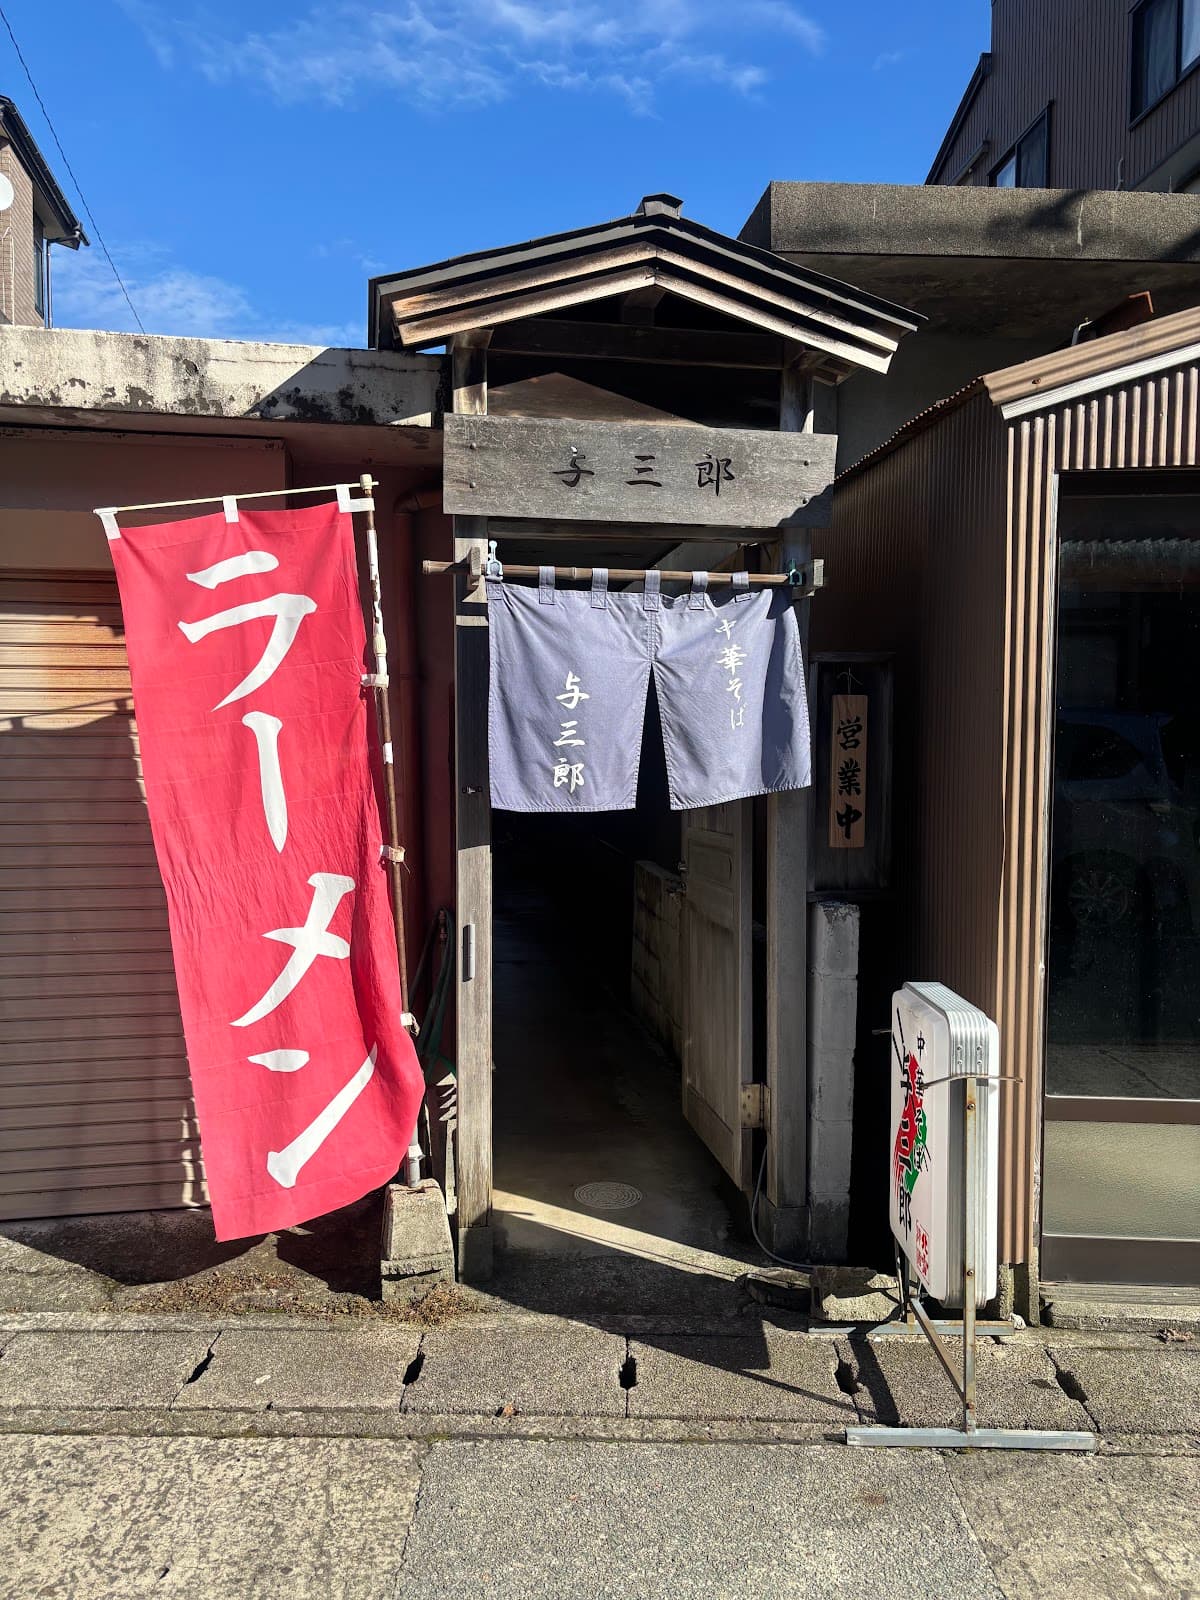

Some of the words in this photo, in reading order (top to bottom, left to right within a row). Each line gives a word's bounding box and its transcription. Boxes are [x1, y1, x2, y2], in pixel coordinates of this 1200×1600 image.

[553, 446, 735, 496] 与三郎
[553, 670, 590, 793] 与三郎
[715, 618, 747, 730] 中華そば
[836, 716, 863, 839] 営業中
[178, 550, 378, 1189] ラーメン
